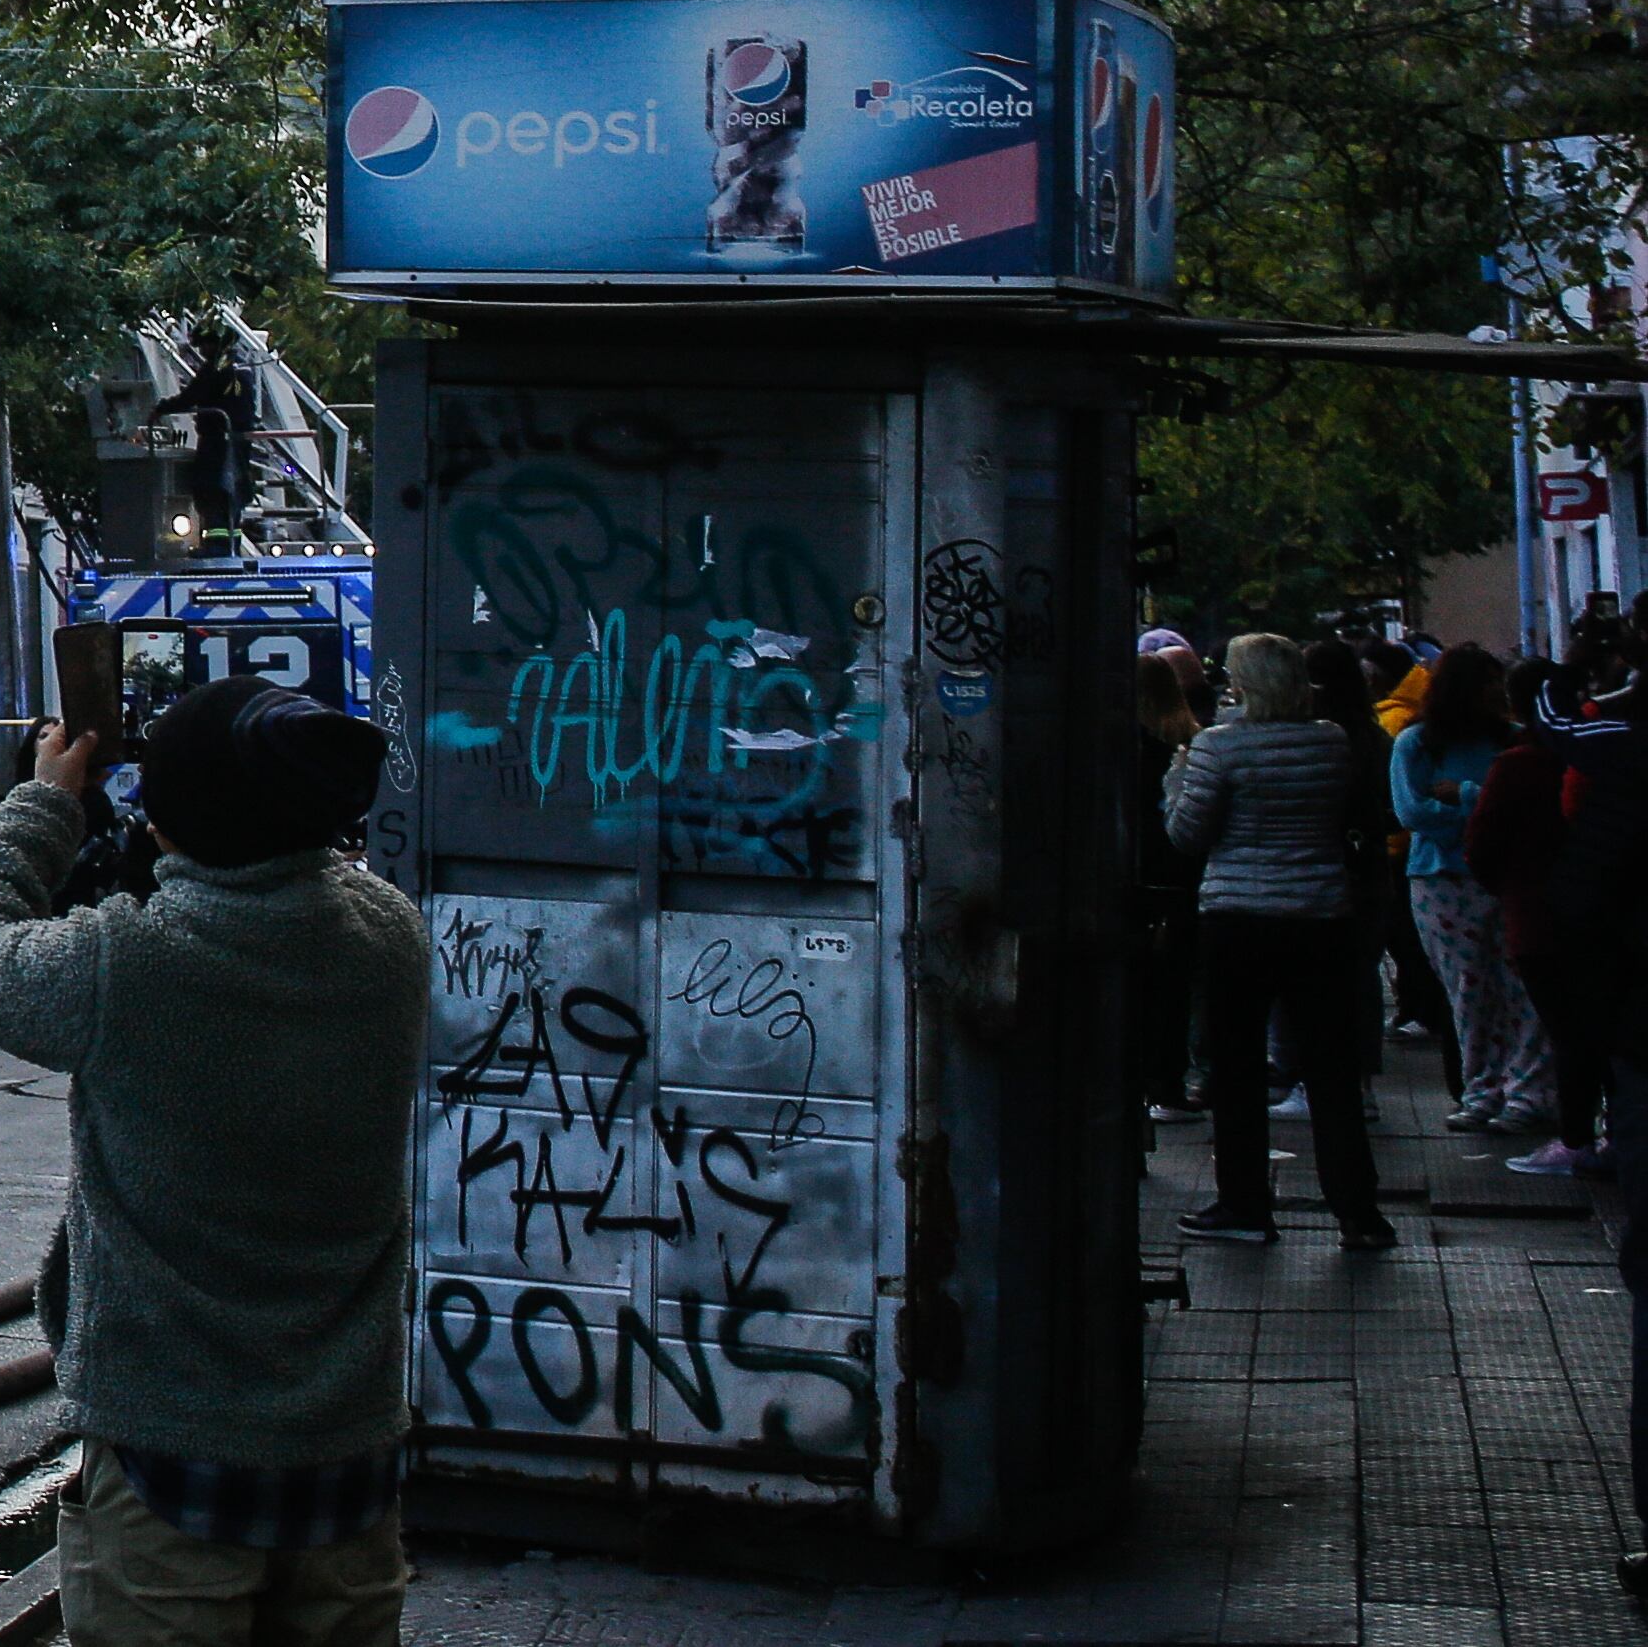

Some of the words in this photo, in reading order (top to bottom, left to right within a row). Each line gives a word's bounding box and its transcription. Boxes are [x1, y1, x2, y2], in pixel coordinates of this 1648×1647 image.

[725, 109, 786, 129] pepsi
[911, 93, 1033, 118] Recoleta
[456, 99, 656, 168] pepsi
[861, 175, 918, 204] VIVIR
[868, 190, 938, 223] MEJOR
[874, 219, 899, 242] ES
[879, 223, 964, 264] POSIBLE
